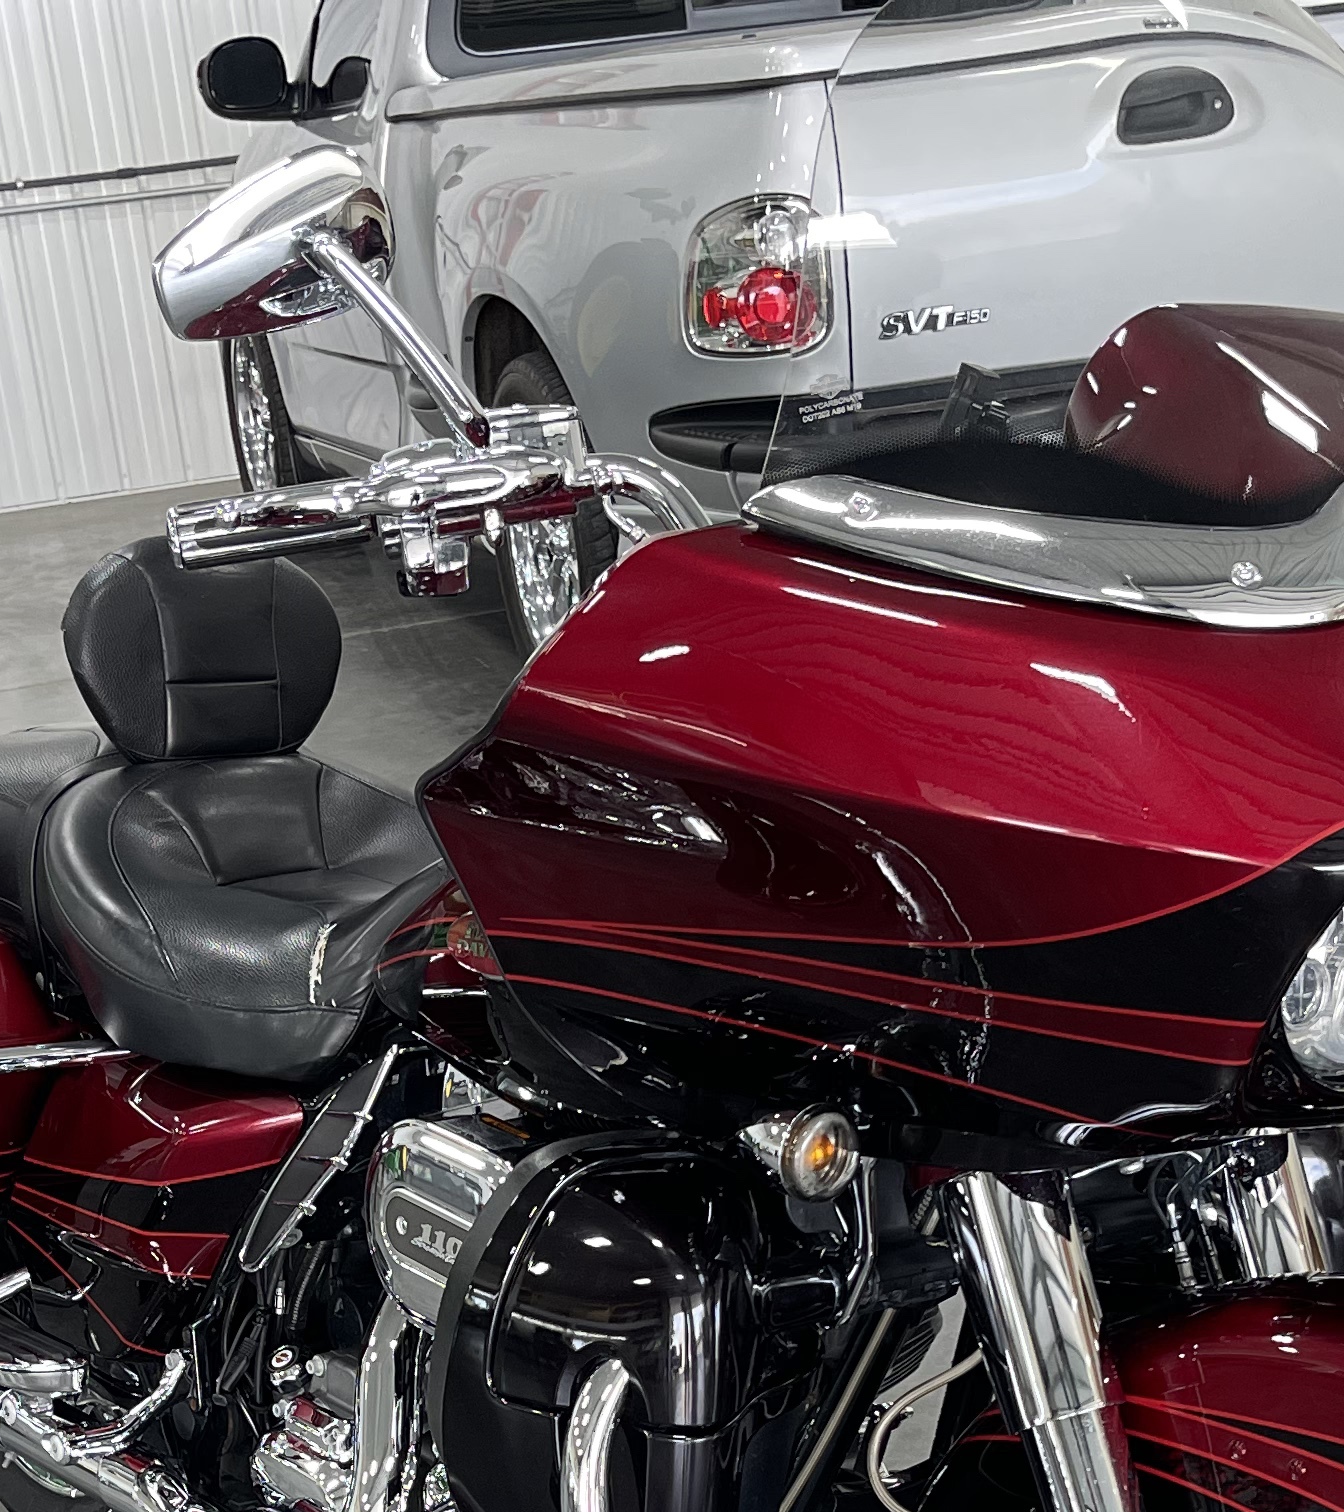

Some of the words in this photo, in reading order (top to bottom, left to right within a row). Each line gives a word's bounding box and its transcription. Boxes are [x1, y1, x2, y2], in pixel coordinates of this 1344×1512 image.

[878, 305, 954, 340] SVT
[798, 391, 864, 414] POLYCARBONATE
[420, 1223, 464, 1260] 110
